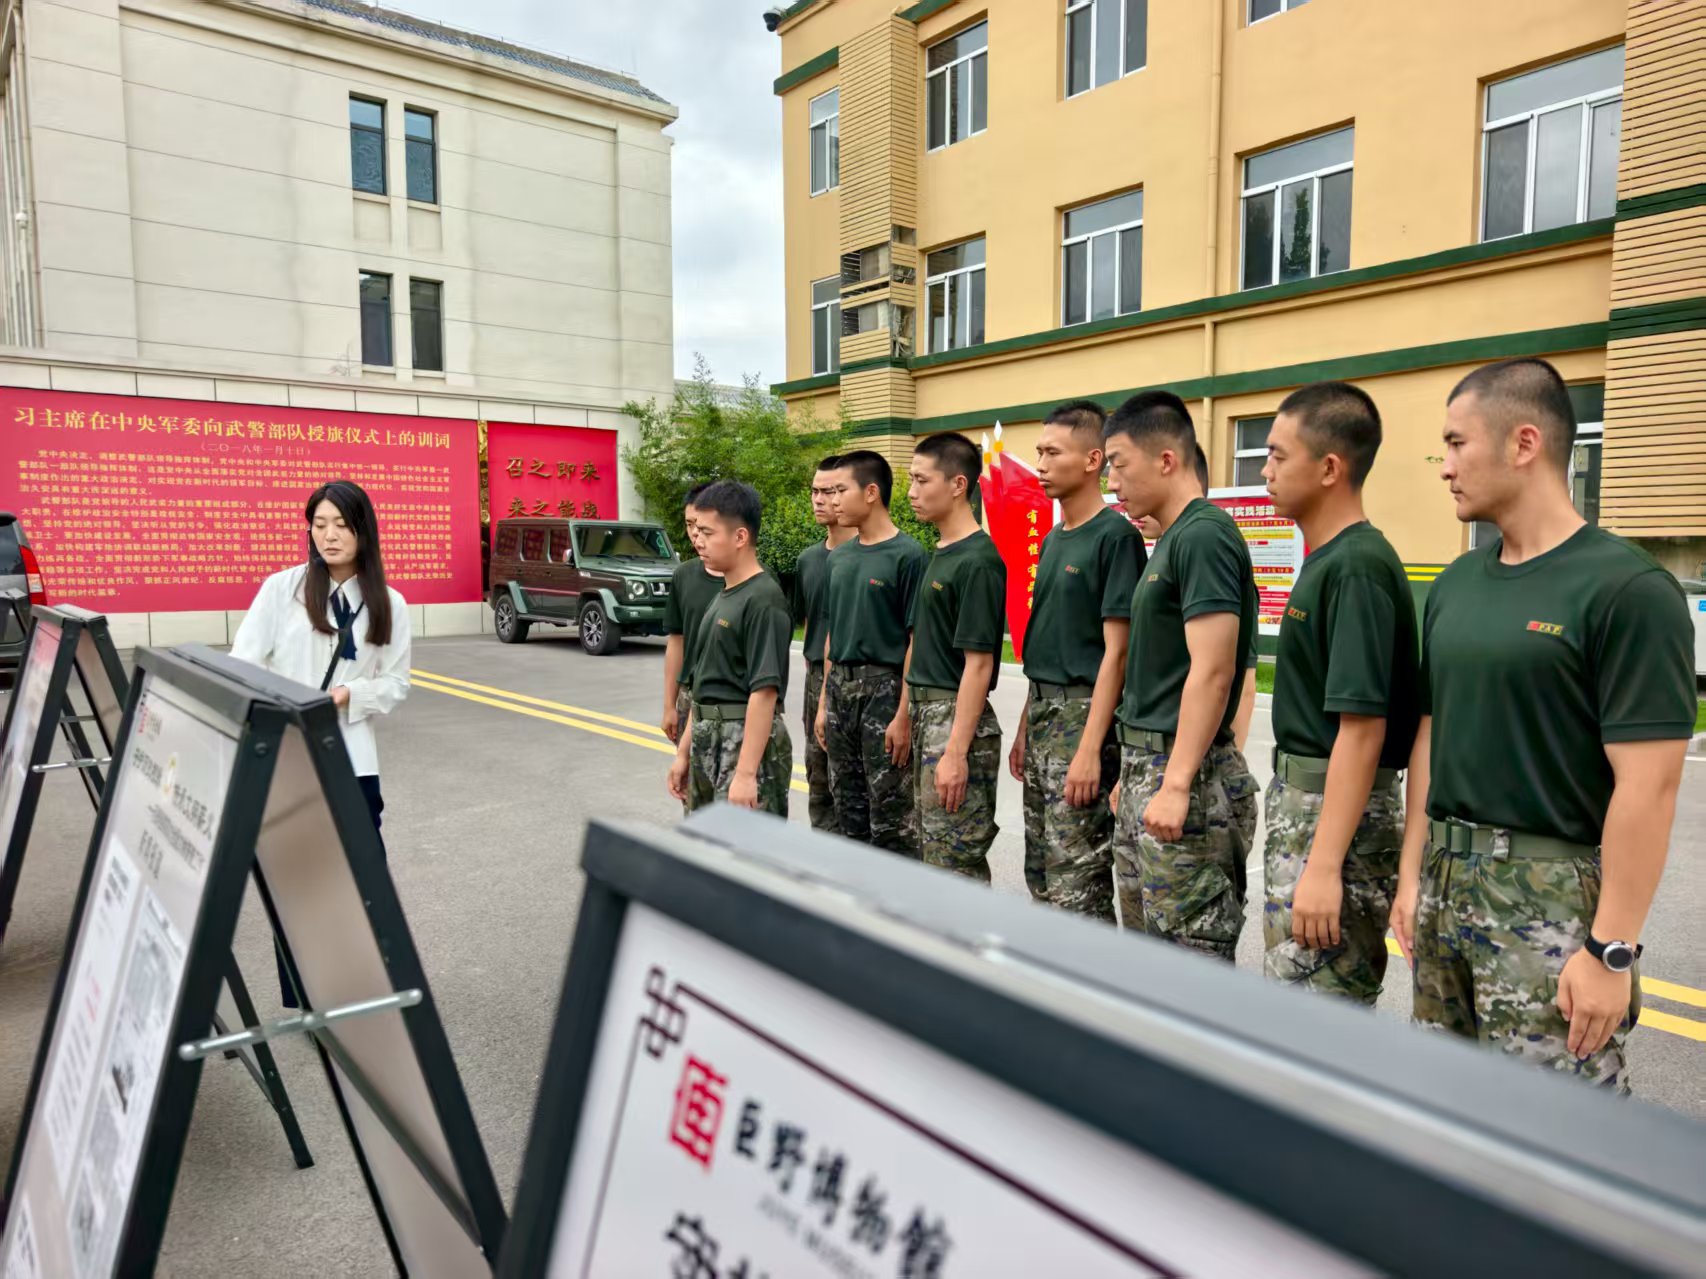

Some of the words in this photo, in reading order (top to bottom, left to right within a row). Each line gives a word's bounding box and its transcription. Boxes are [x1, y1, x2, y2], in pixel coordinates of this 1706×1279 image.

[14, 406, 450, 449] 习主席在中央军委向武警部队授旗仪式上的训词
[506, 457, 600, 482] 召之即来
[507, 496, 601, 518] 来之能战
